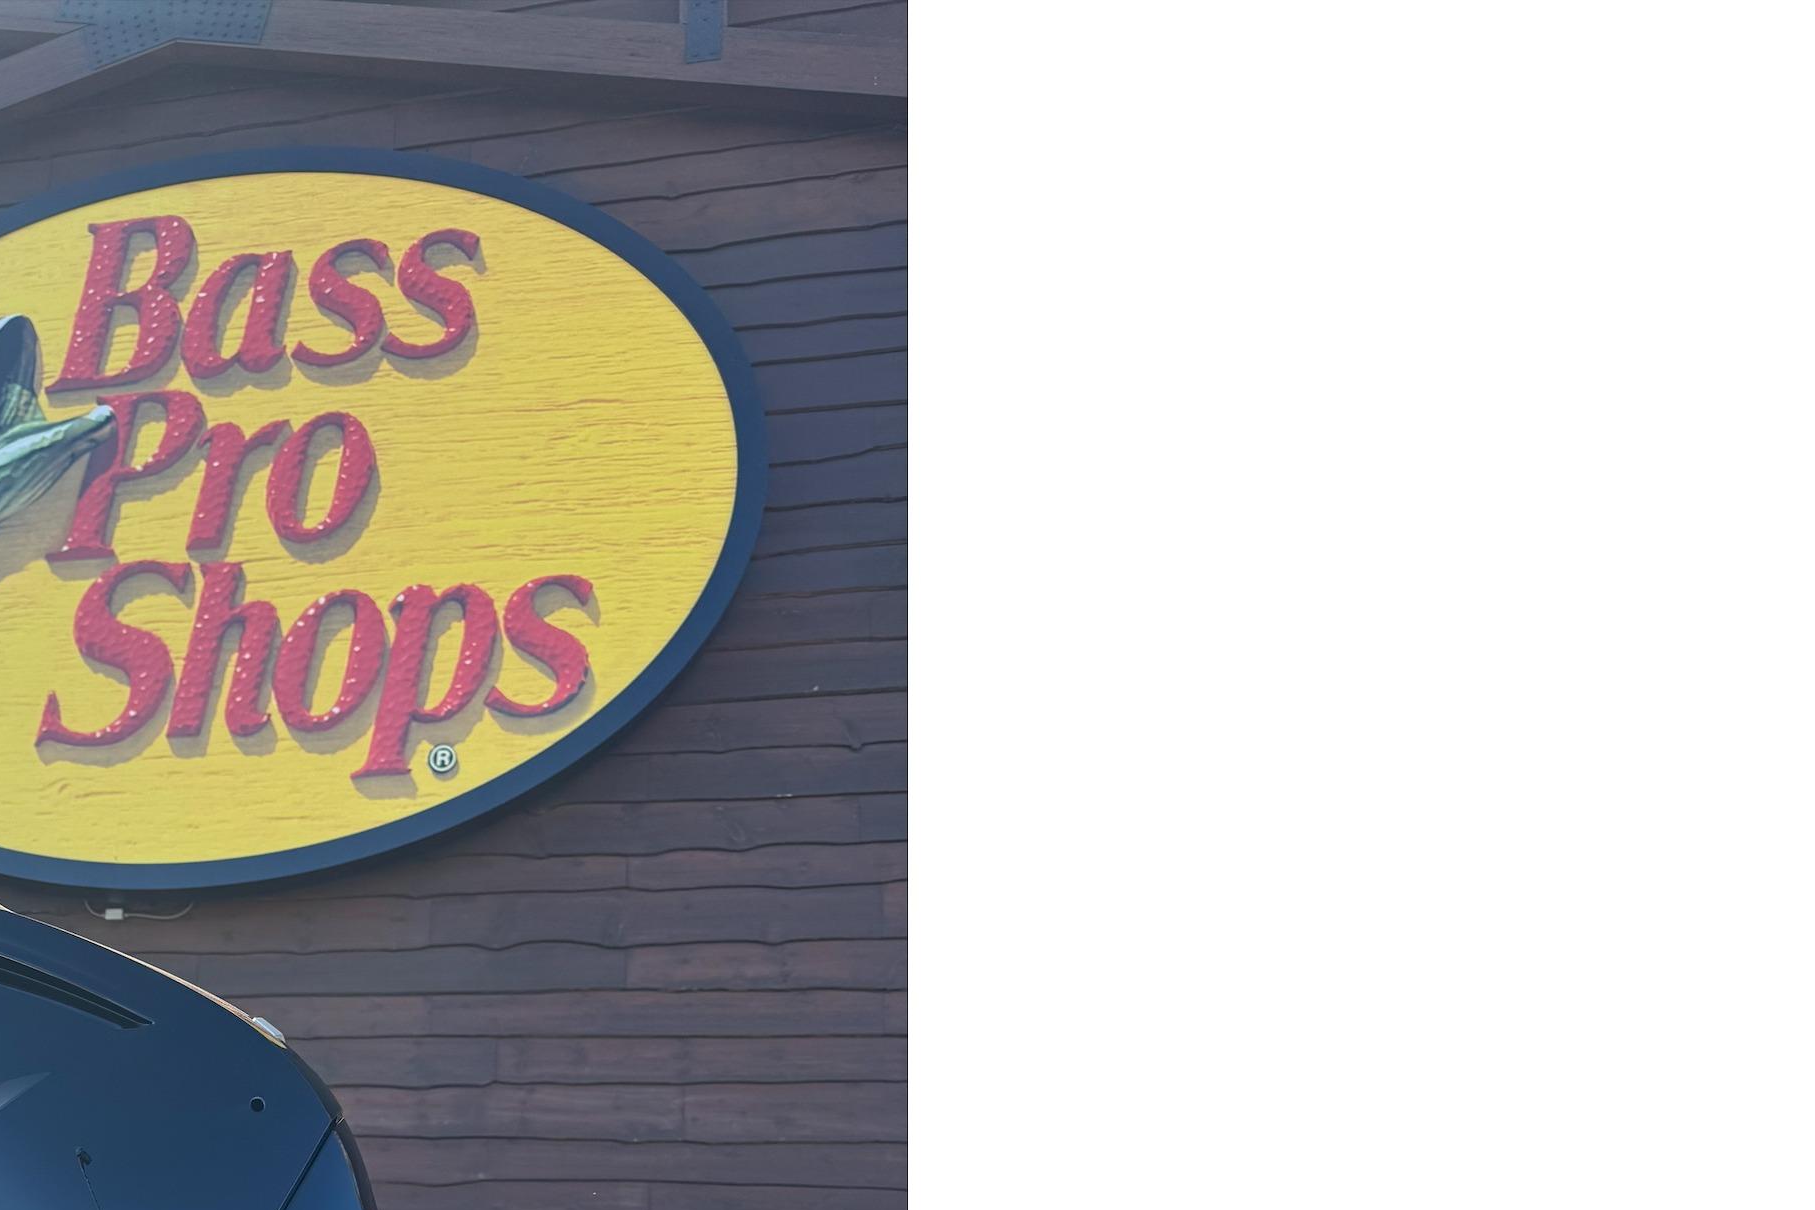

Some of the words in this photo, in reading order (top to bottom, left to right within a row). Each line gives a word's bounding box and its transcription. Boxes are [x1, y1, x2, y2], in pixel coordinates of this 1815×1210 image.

[46, 214, 481, 395] Bass
[46, 390, 377, 562] Pro
[35, 560, 593, 778] Shops
